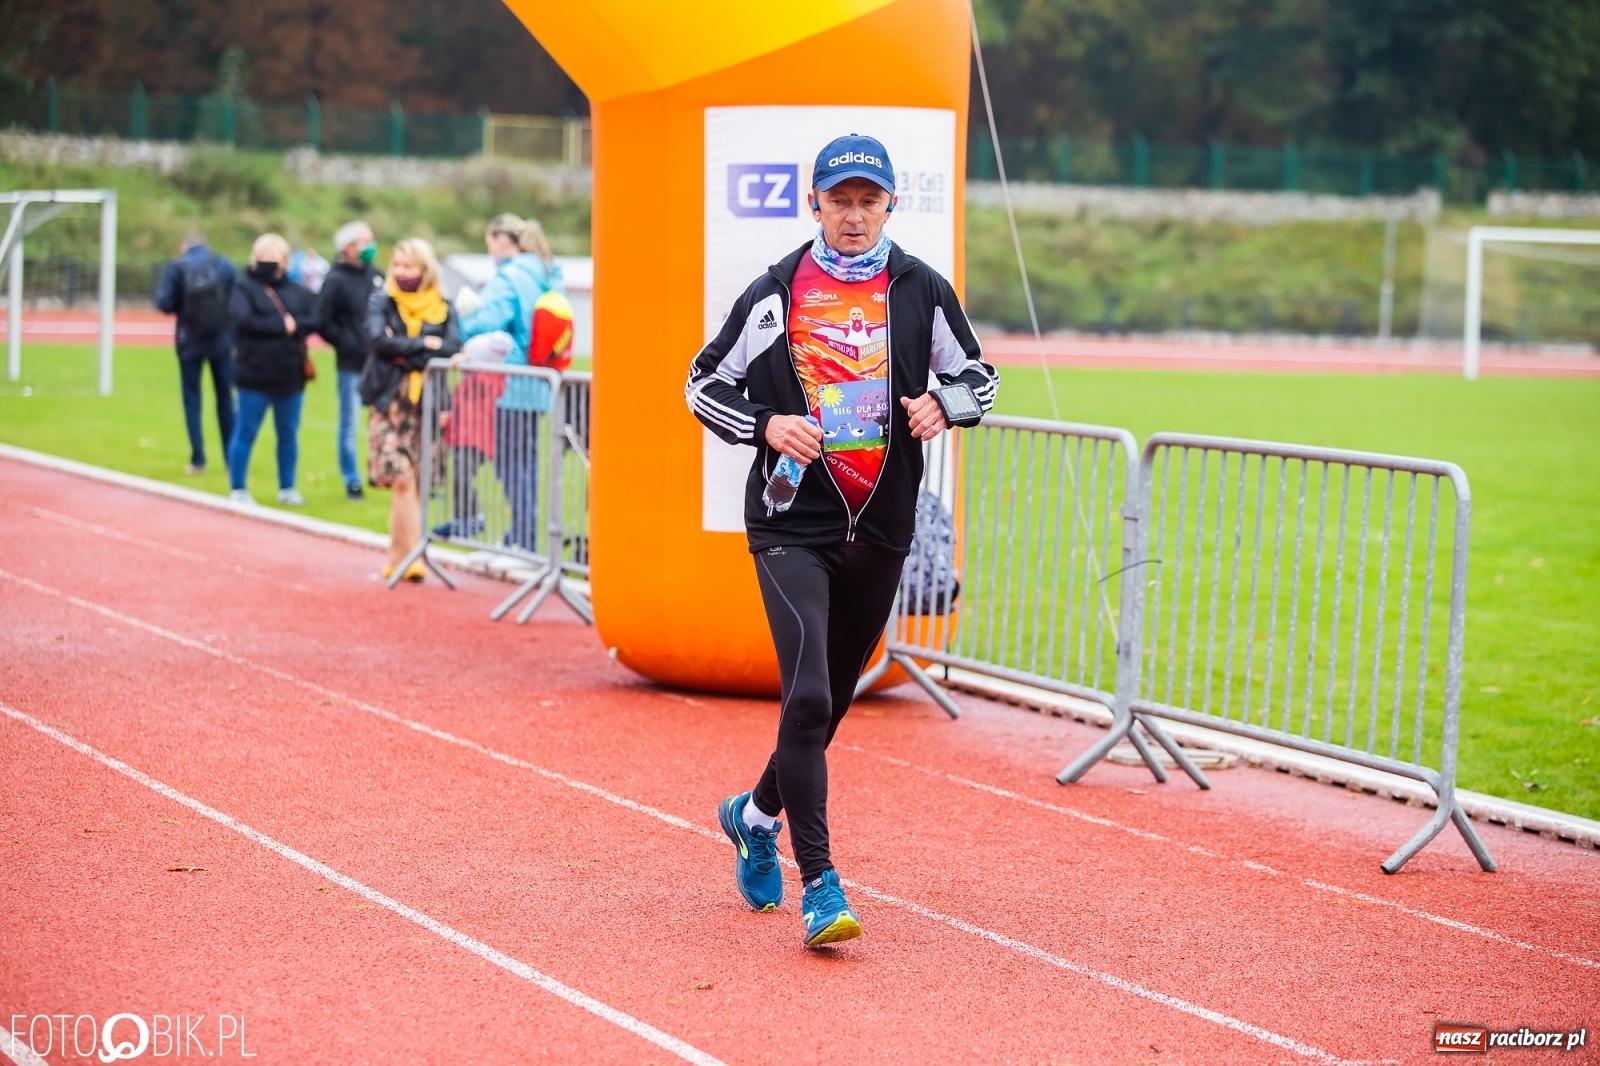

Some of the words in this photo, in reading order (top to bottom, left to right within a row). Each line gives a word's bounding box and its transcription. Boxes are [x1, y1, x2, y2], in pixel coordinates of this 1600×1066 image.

[828, 151, 883, 169] adidas
[737, 172, 792, 209] CZ
[758, 321, 778, 330] adidas
[860, 340, 886, 359] MARATON
[833, 406, 852, 416] BIEG
[856, 404, 872, 414] DLA
[876, 402, 889, 411] BO
[837, 461, 860, 480] TYCH
